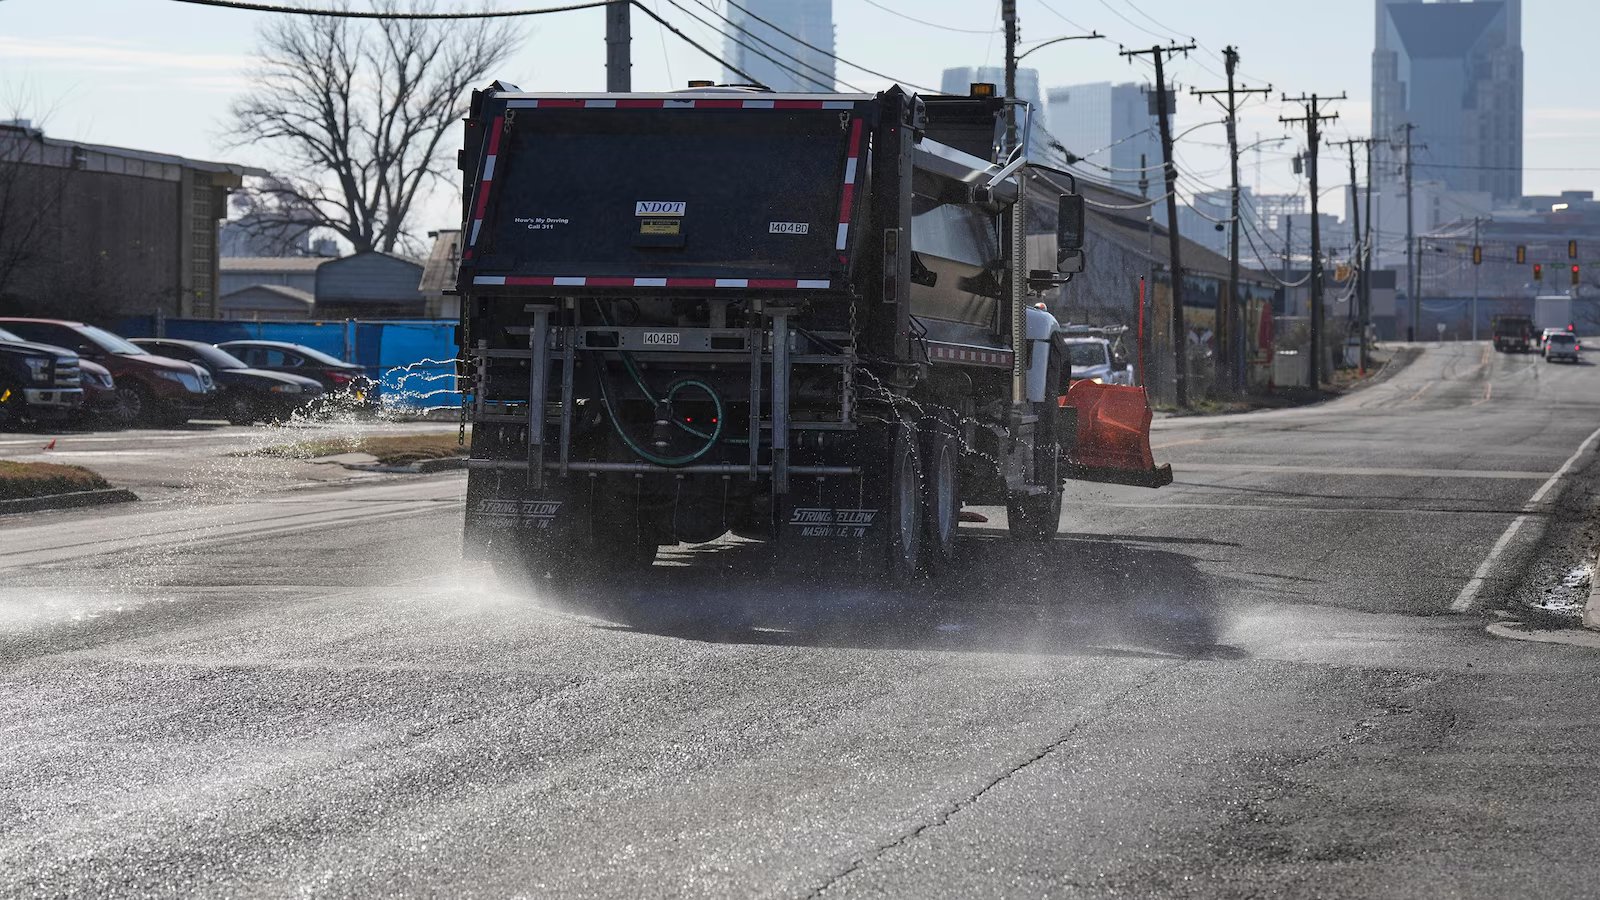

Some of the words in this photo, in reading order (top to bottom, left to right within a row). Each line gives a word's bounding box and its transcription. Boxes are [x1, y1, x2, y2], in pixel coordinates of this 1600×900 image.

[638, 202, 684, 213] NDOT
[644, 332, 679, 344] 1404BD
[477, 499, 561, 515] STRINGELLOW
[790, 507, 876, 523] STRINGELLOW
